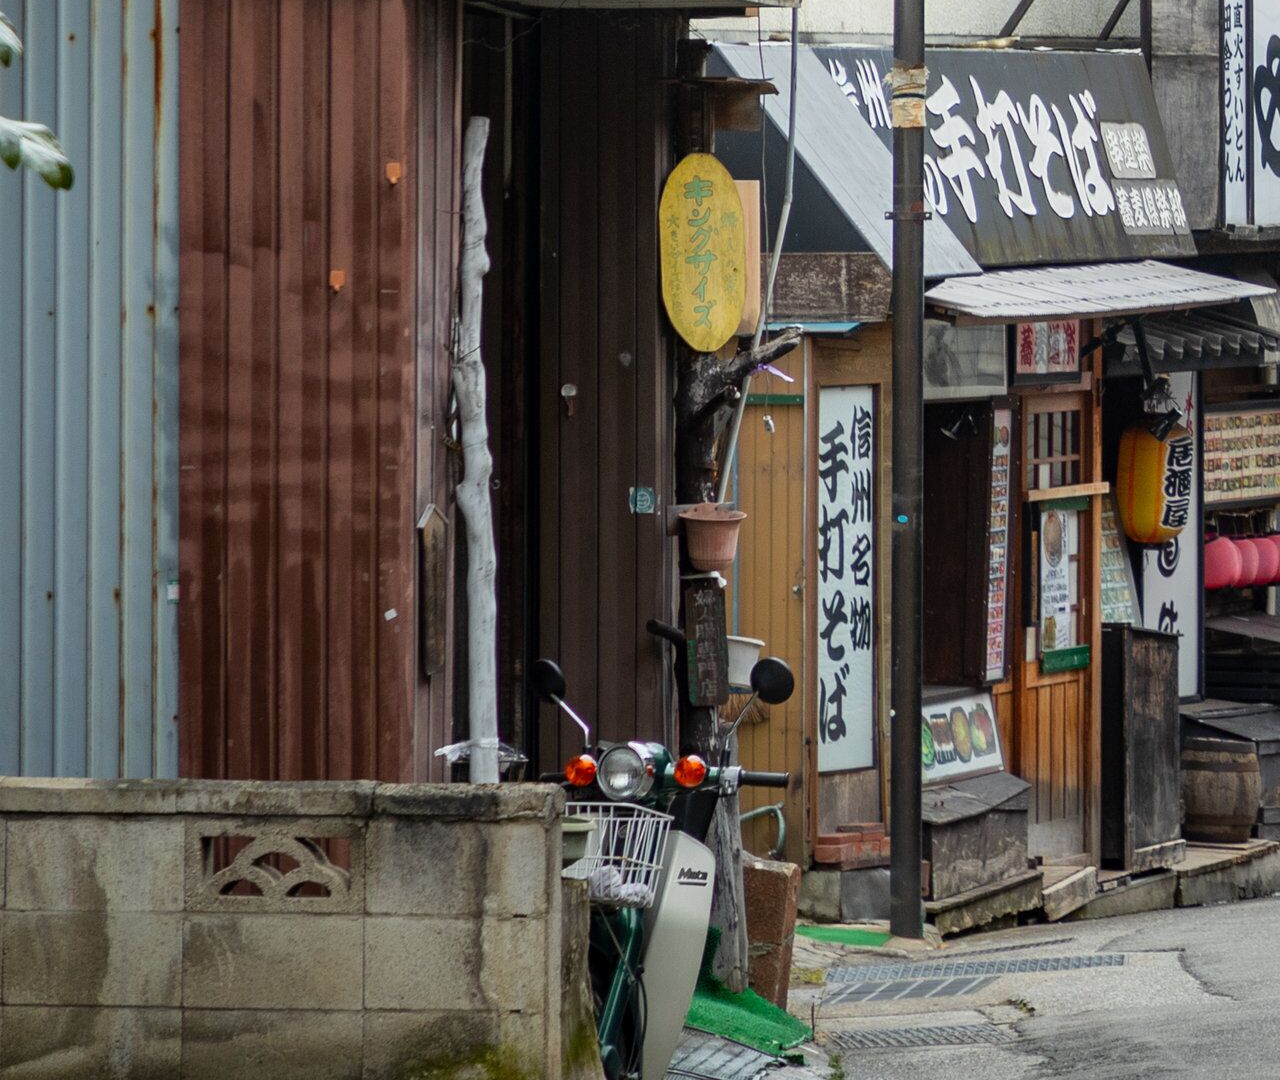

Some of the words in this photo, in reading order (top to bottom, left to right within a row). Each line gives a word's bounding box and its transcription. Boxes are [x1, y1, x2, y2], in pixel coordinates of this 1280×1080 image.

[682, 174, 719, 330] キングサイズ
[819, 420, 850, 745] 手打そば
[850, 405, 871, 653] 信州名物
[1162, 435, 1194, 530] 居酒屋
